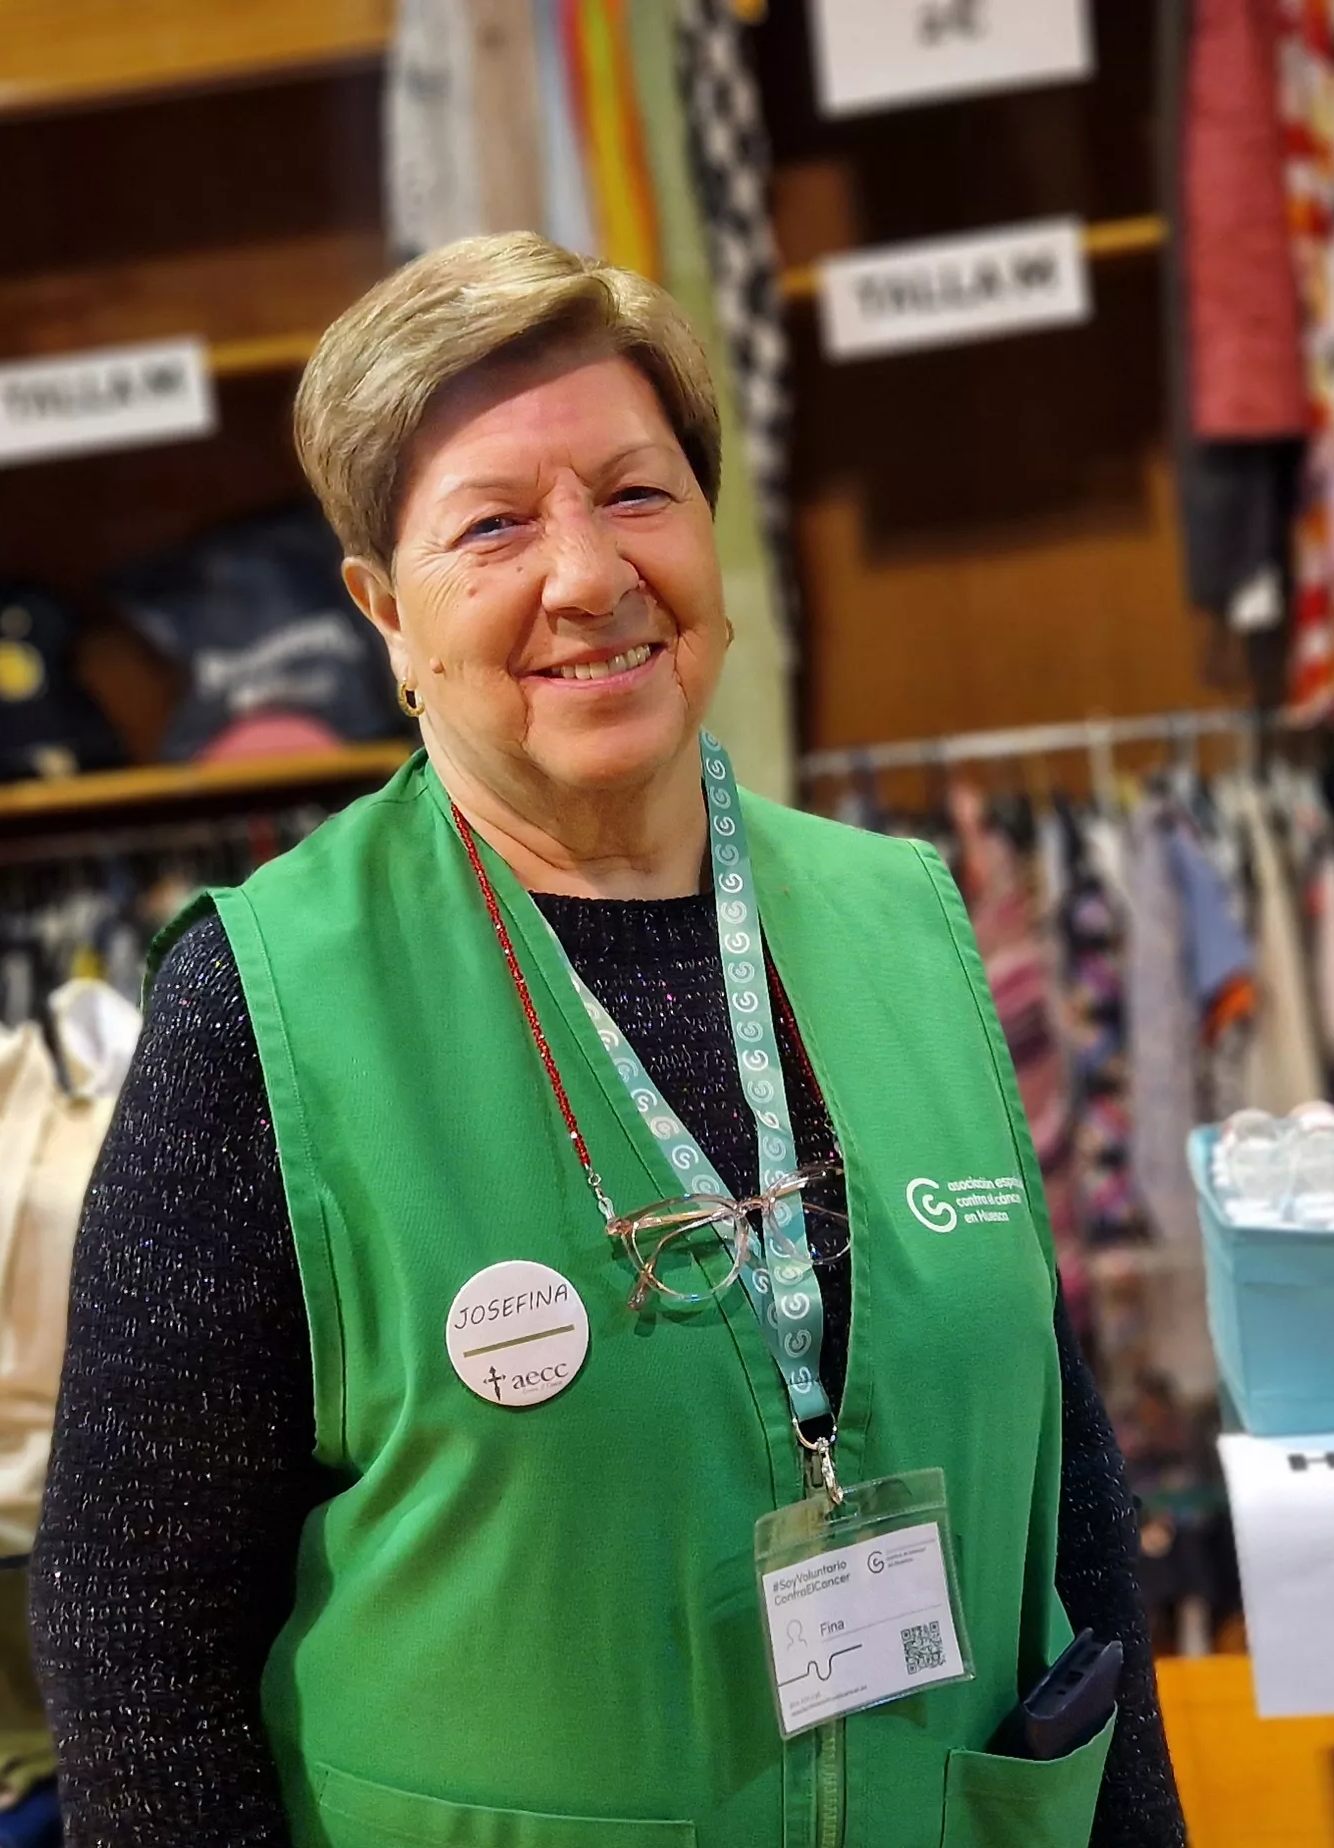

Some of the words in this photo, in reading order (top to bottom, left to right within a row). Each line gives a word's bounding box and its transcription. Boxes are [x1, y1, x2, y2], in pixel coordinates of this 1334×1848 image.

[948, 1176, 995, 1191] asociación
[956, 1193, 987, 1208] contra
[964, 1212, 978, 1223] en
[976, 1209, 1009, 1222] Huesca
[454, 1283, 568, 1330] JOSEFINA
[511, 1363, 569, 1390] aecc
[772, 1560, 847, 1593] #SoyVoluntario
[774, 1572, 851, 1606] ContraElCancer
[820, 1620, 845, 1637] Fina
